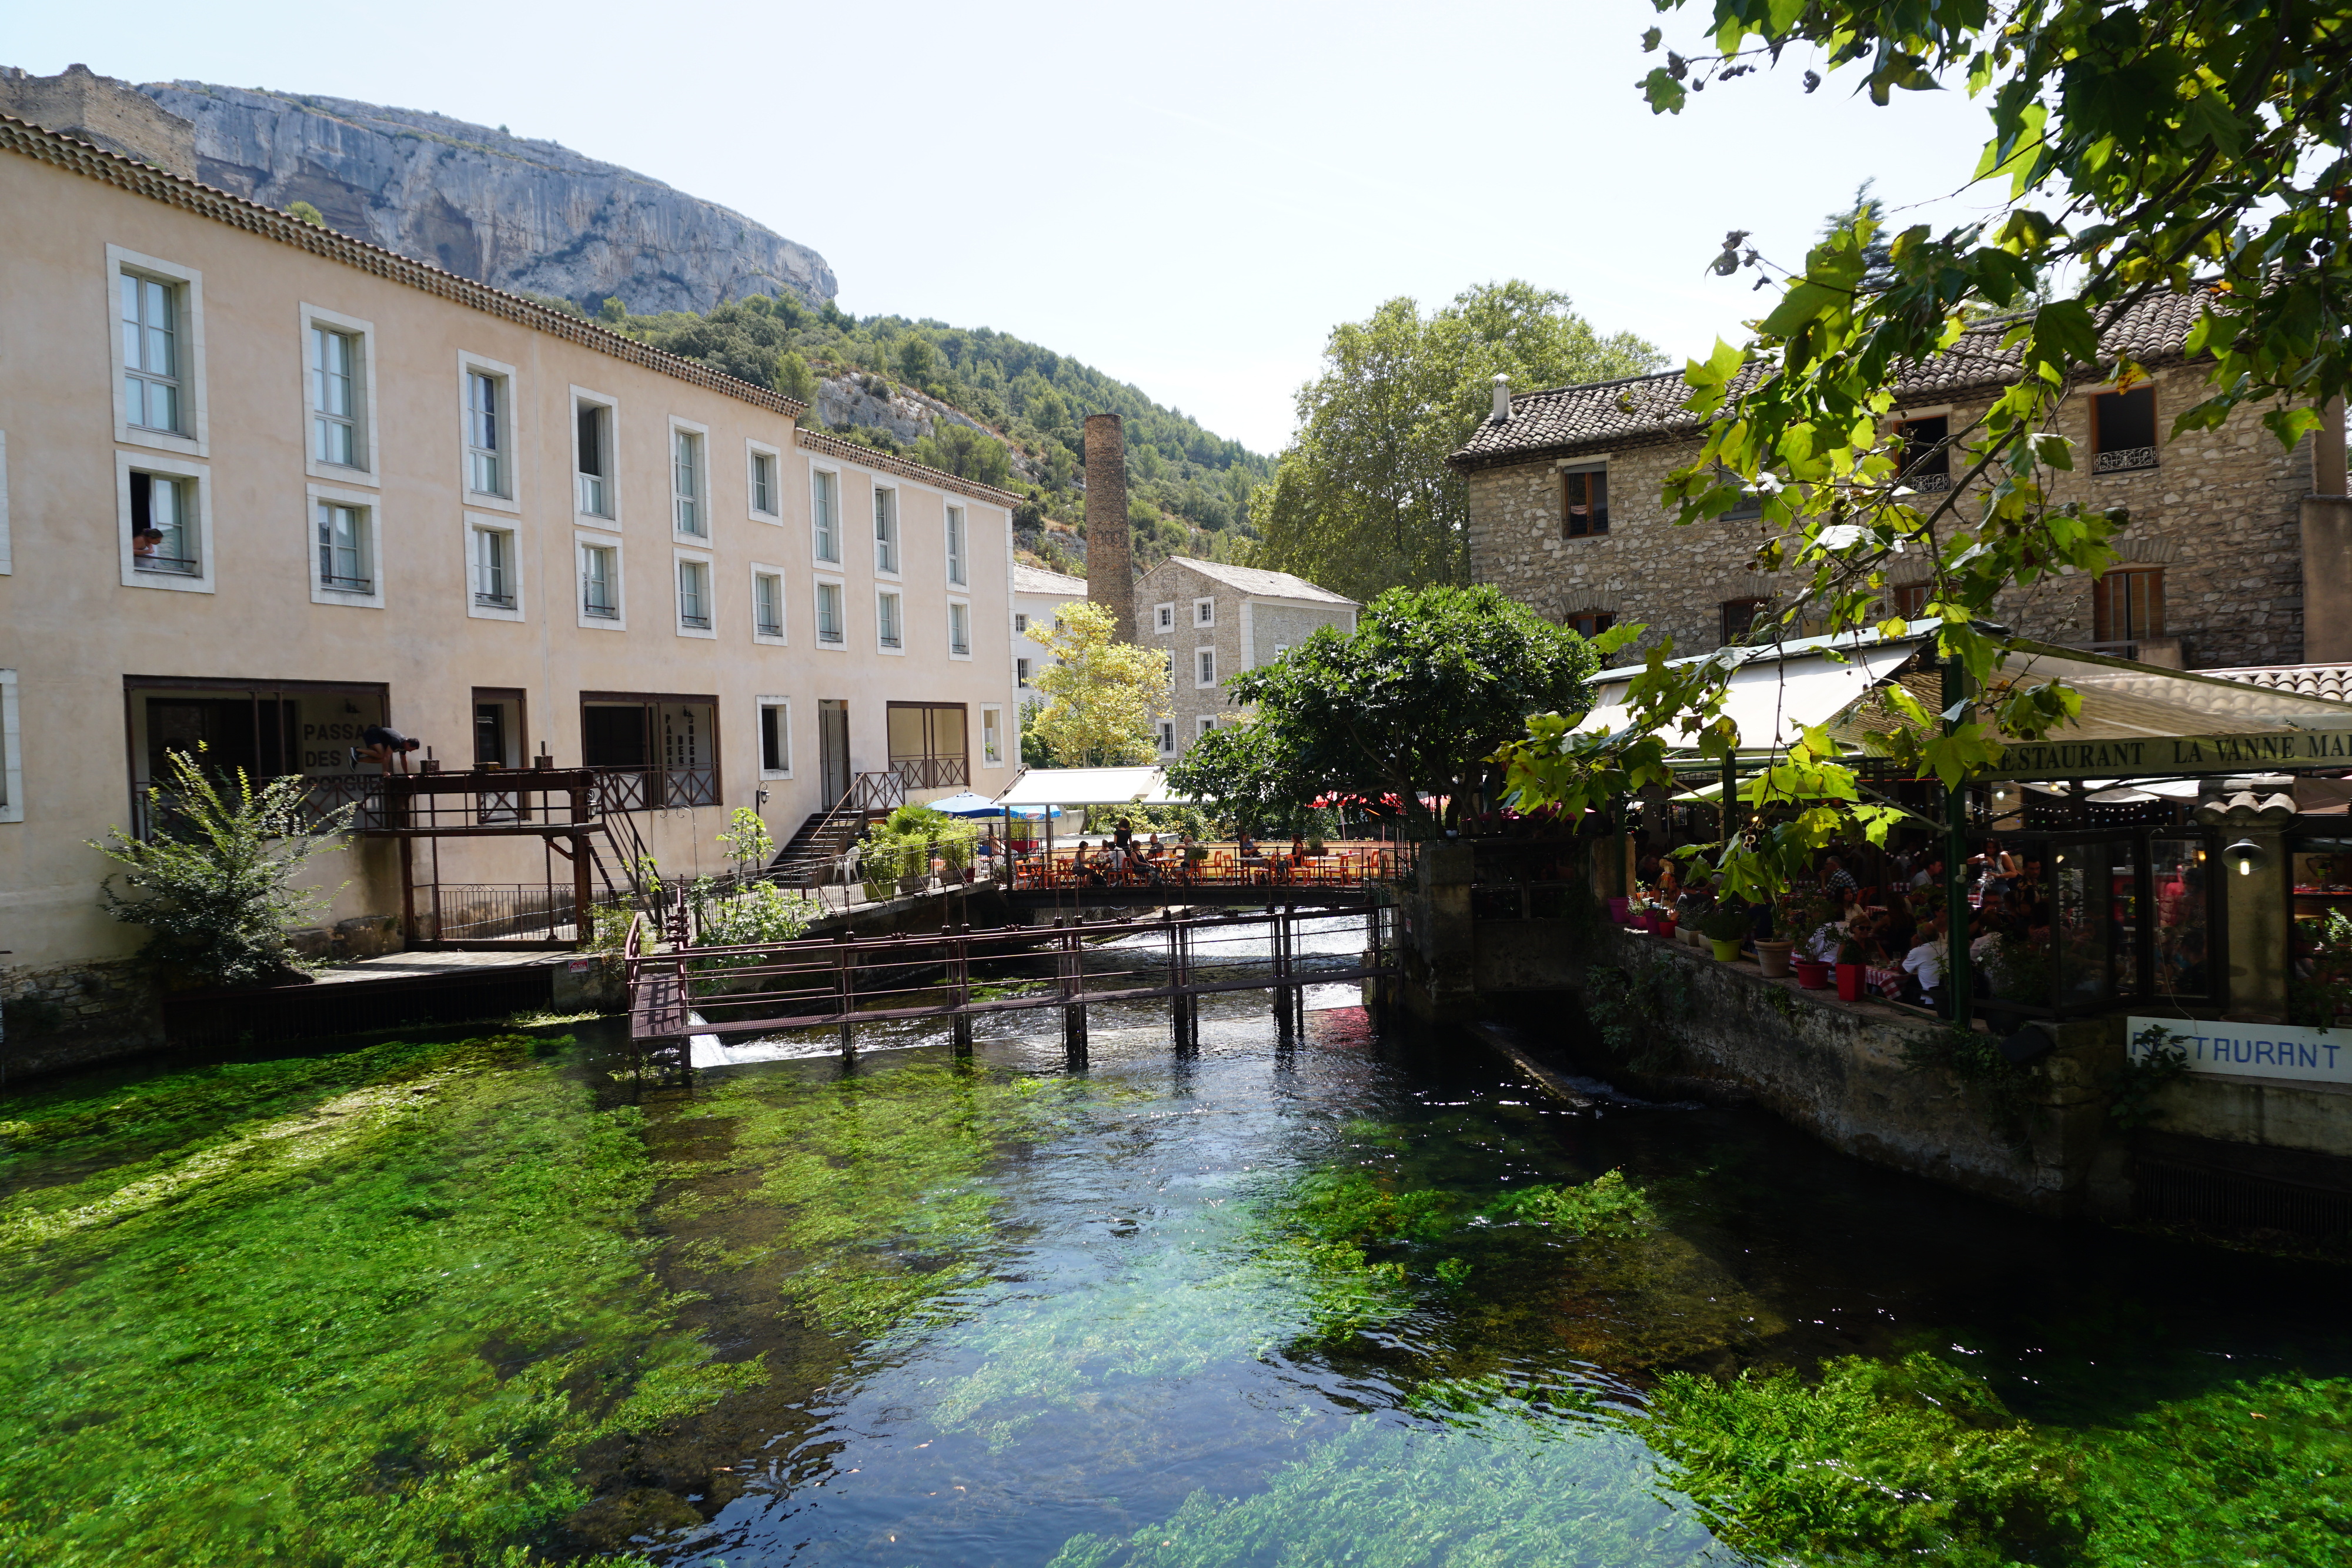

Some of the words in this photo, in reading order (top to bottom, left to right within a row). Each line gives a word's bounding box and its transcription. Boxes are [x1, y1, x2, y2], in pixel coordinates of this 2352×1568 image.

[303, 723, 378, 740] PASSA
[2173, 740, 2204, 764] LA
[2214, 736, 2295, 762] VANNE
[2307, 734, 2352, 758] MA
[305, 750, 341, 767] DES
[306, 775, 384, 793] SORGUE
